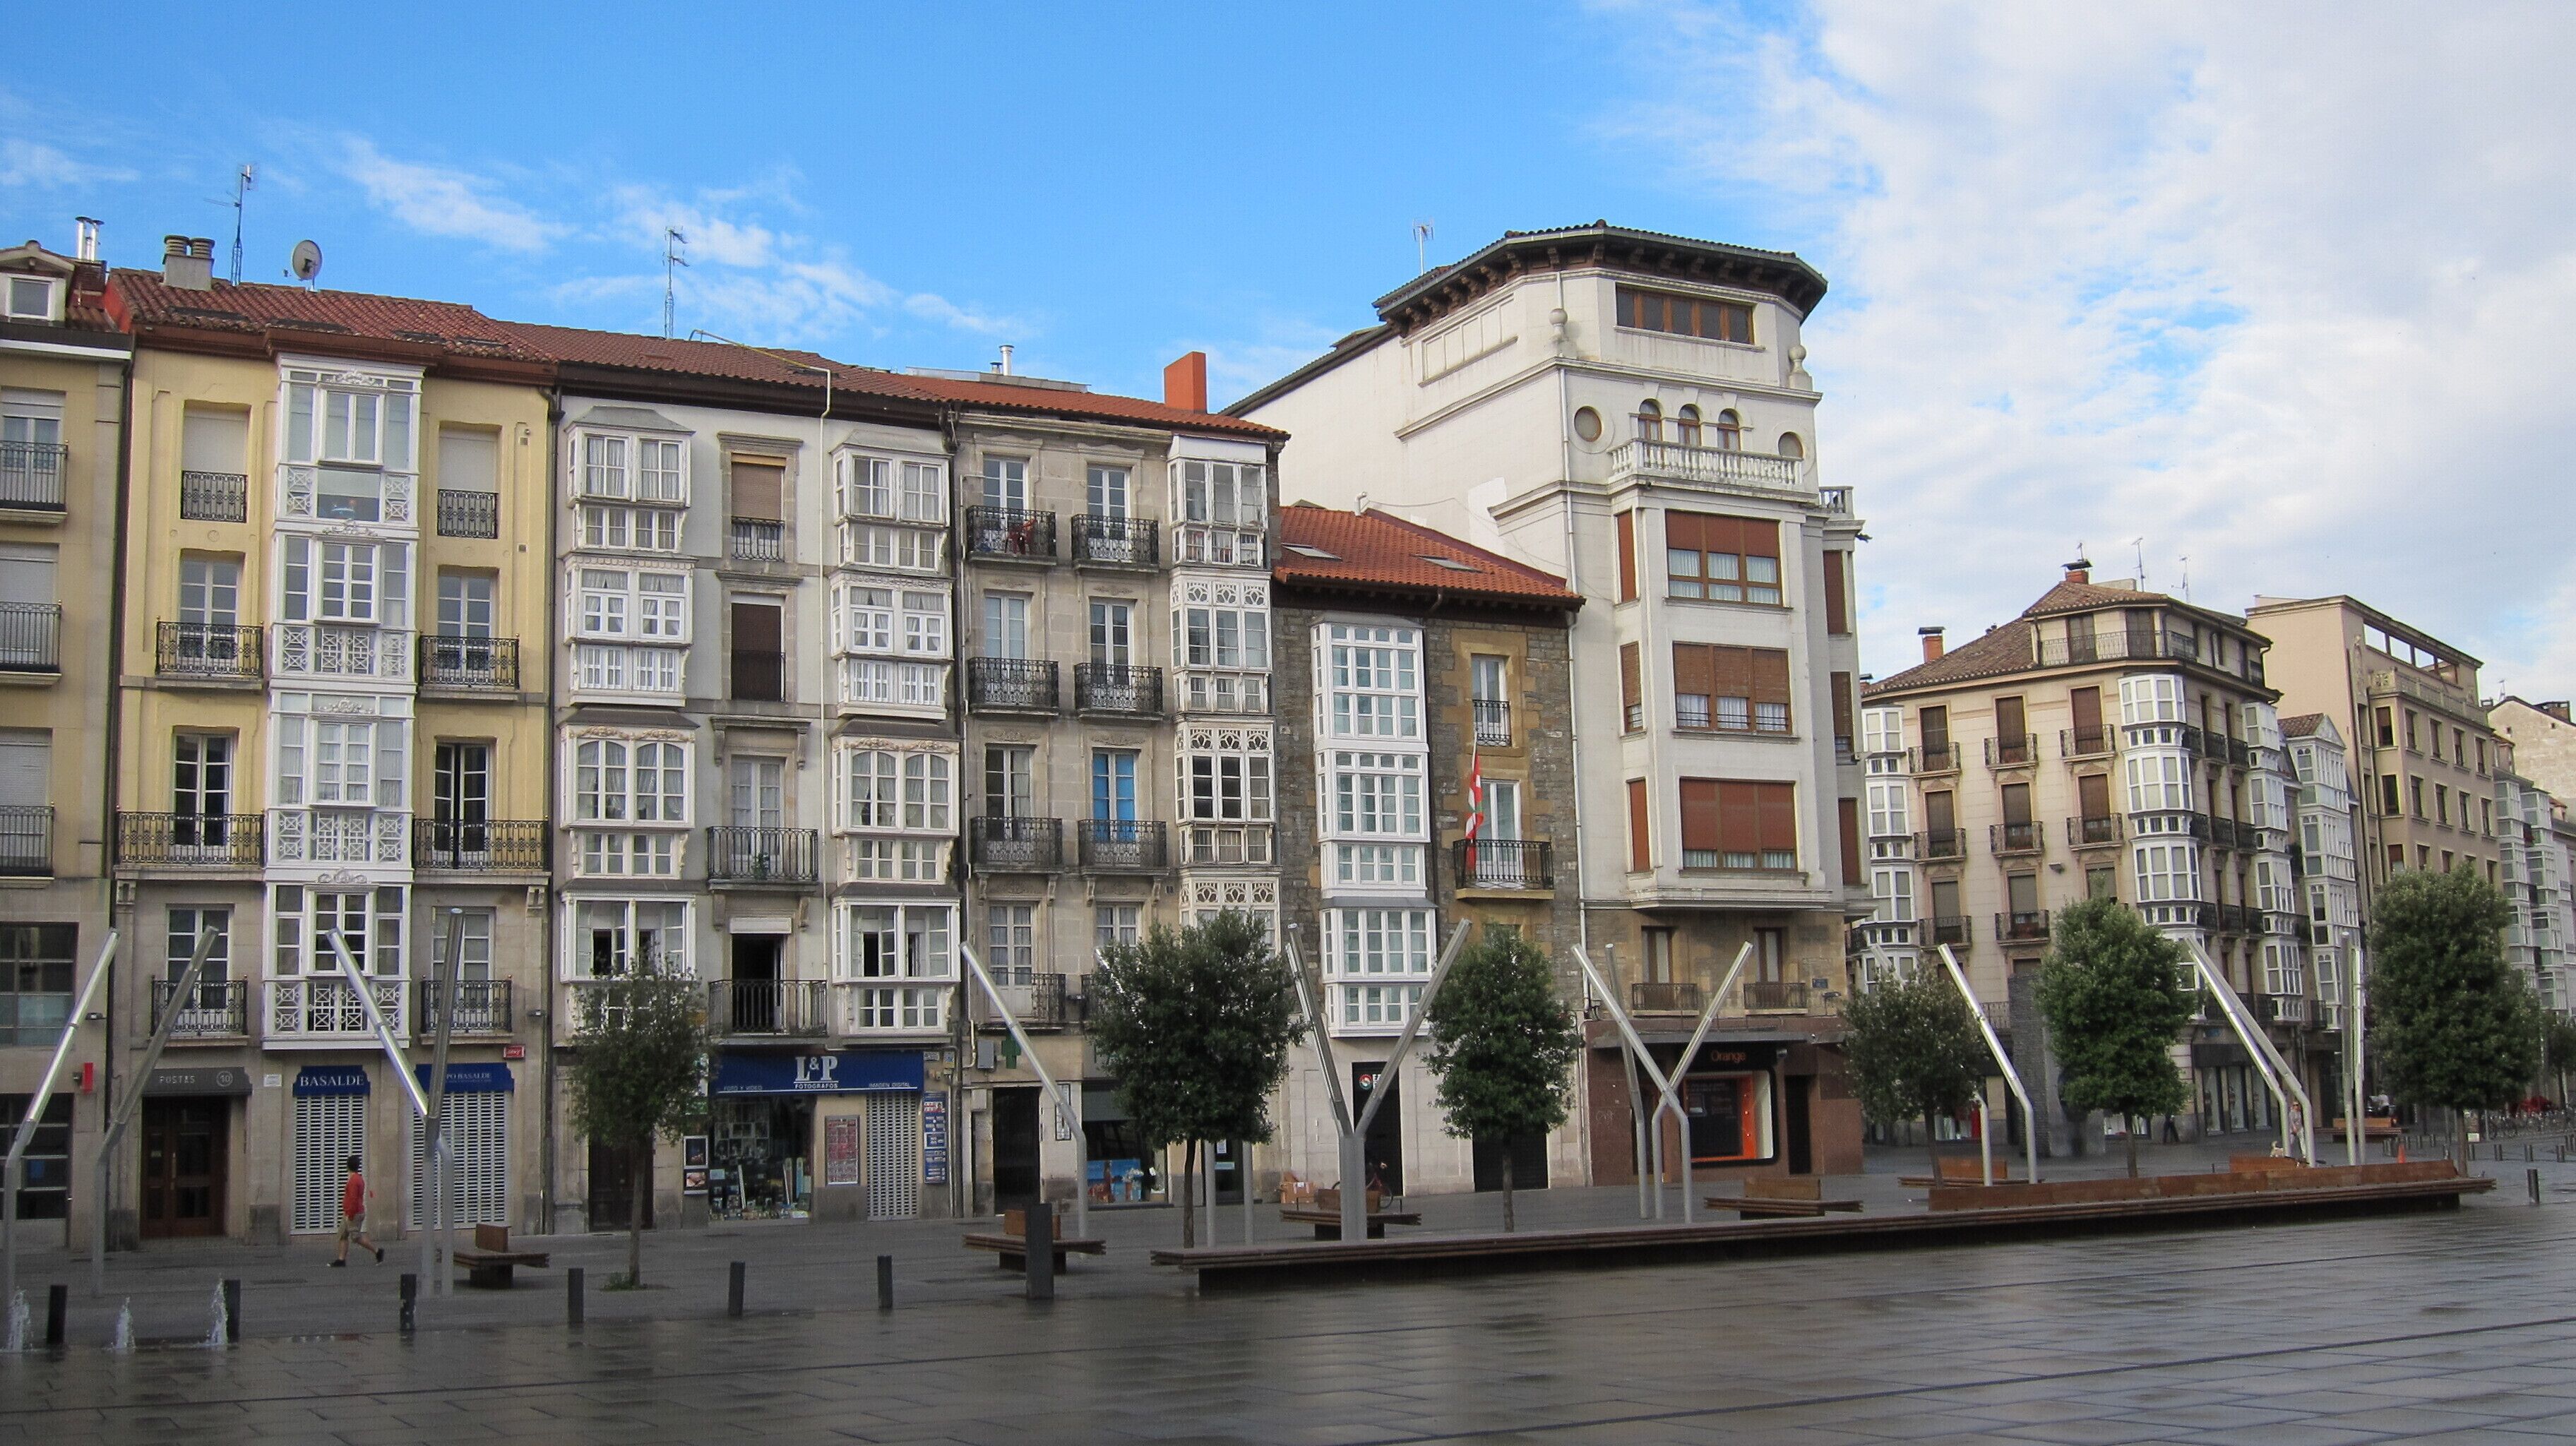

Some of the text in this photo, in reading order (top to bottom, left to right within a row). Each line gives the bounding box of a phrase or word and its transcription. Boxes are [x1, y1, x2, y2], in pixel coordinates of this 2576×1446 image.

[1712, 1050, 1746, 1063] Orange
[795, 1056, 838, 1081] L&P
[159, 1075, 196, 1084] POSTAS
[300, 1075, 364, 1087] BASALDE
